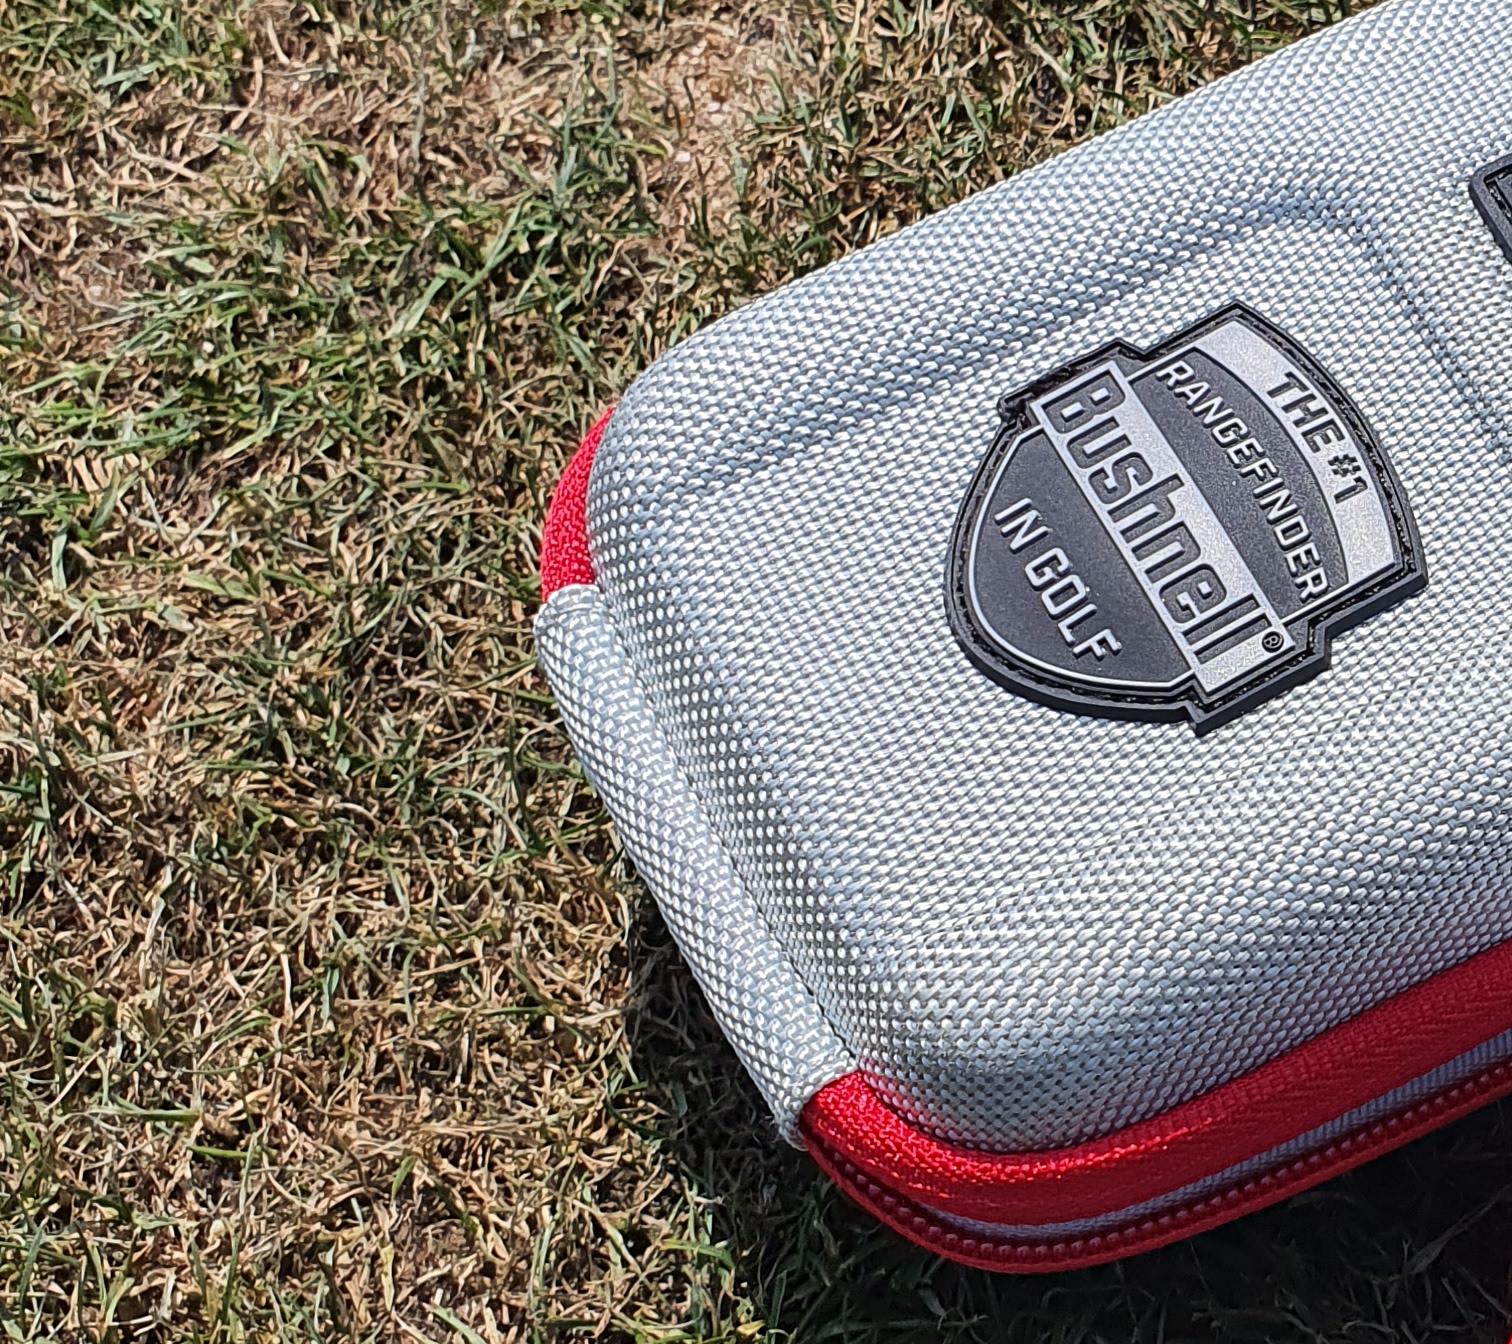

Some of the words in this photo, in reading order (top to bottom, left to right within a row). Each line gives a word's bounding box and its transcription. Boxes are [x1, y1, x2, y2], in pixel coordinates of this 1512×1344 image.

[1156, 360, 1331, 603] RANGEFINDER
[1265, 371, 1345, 454] THE
[1327, 454, 1369, 504] #1
[995, 498, 1051, 552] IN
[1024, 546, 1121, 661] GOLF
